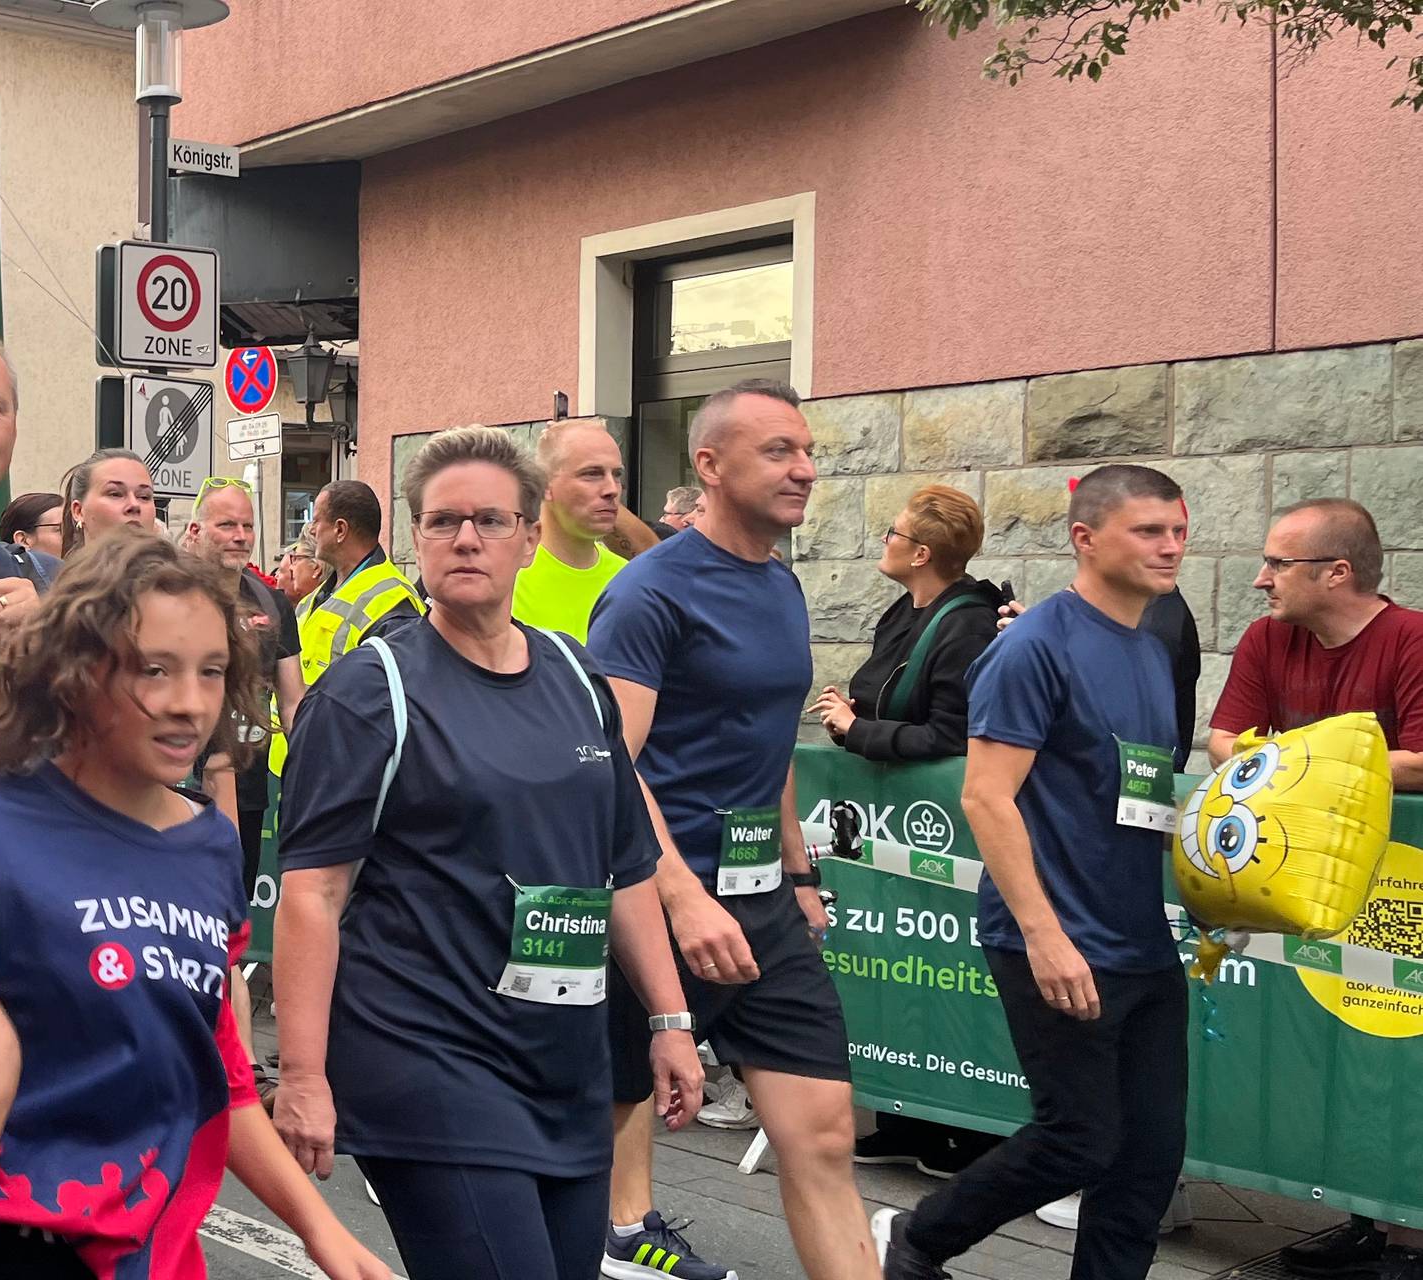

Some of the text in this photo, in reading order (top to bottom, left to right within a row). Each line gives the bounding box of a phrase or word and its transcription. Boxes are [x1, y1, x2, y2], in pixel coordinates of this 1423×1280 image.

[173, 144, 233, 170] Königstr.
[151, 275, 187, 311] 20
[144, 336, 192, 356] ZONE
[1126, 759, 1158, 779] Peter
[730, 826, 773, 842] Walter
[74, 895, 230, 954] ZUSAMME
[526, 909, 606, 935] Christina
[846, 908, 884, 934] zu
[895, 907, 959, 943] 500
[522, 937, 565, 958] 3141
[1294, 944, 1332, 964] AOK
[97, 947, 128, 984] &
[822, 950, 1000, 998] esundheits
[848, 1042, 921, 1069] ordWest.
[926, 1053, 956, 1075] Die
